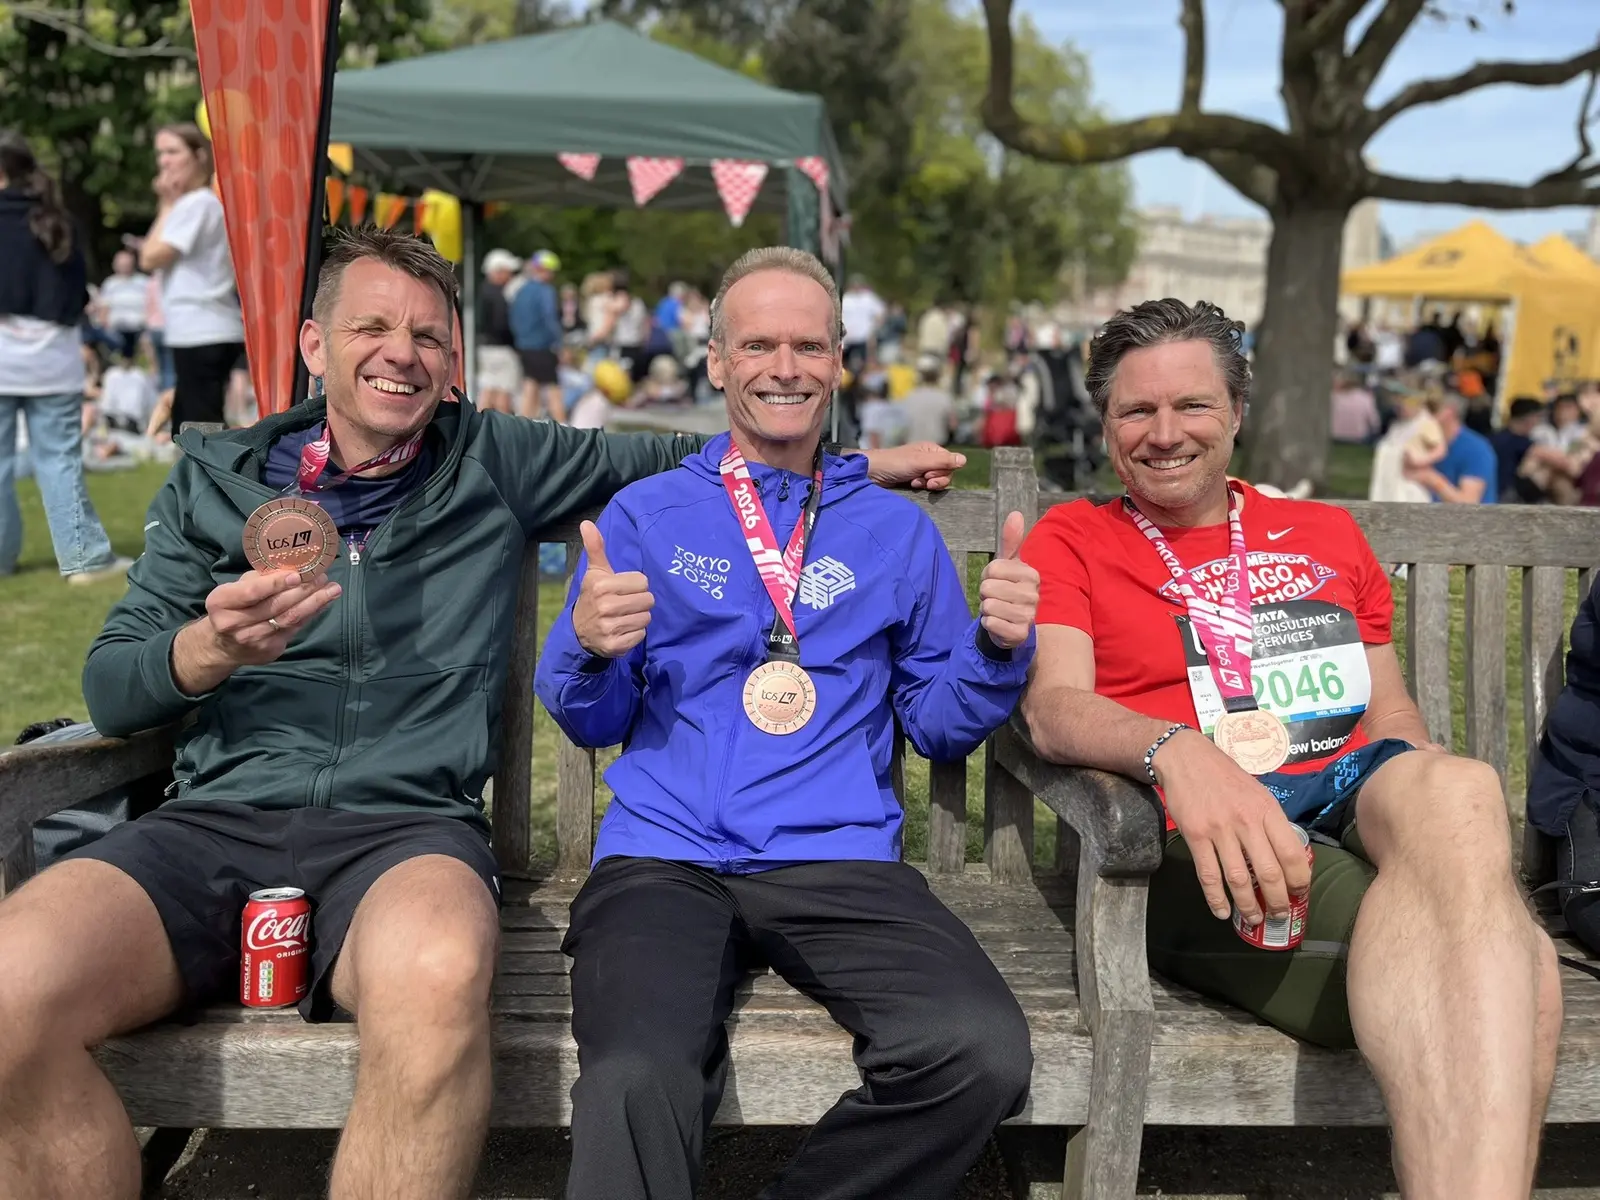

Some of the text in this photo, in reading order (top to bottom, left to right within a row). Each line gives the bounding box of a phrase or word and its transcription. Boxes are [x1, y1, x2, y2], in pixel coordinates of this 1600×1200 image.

[733, 482, 761, 530] 2026
[267, 538, 290, 550] tcs
[674, 544, 731, 573] TOKYO
[1246, 554, 1309, 567] MERICA
[667, 559, 724, 600] 2026
[1251, 609, 1289, 624] TATA
[1253, 612, 1341, 637] CONSULTANCY
[770, 634, 781, 643] tcs
[1257, 629, 1315, 649] SERVICES
[761, 689, 778, 701] tcs
[1288, 742, 1310, 755] ew
[276, 947, 309, 959] ORIGINA
